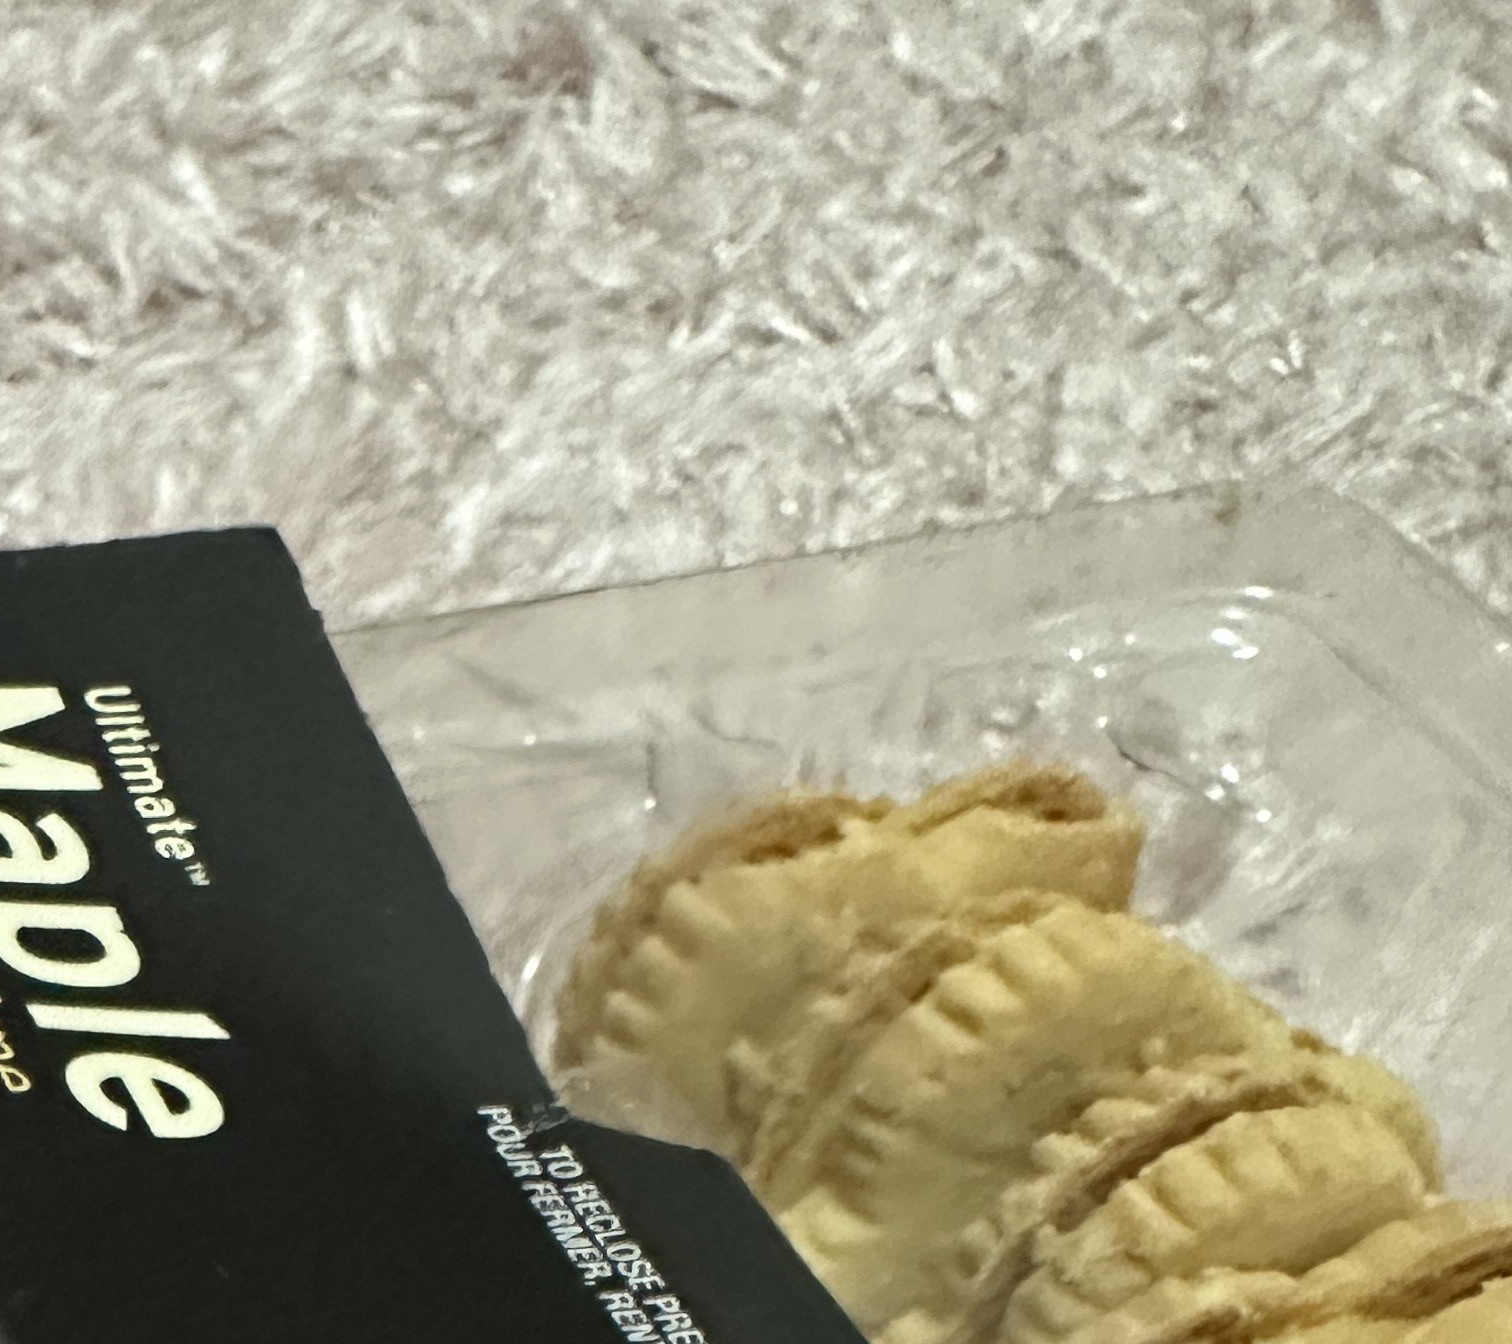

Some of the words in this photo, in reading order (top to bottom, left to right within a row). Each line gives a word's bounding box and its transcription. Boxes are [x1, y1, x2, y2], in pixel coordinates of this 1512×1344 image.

[477, 1105, 543, 1178] POUR
[540, 1144, 583, 1179] TO
[562, 1181, 665, 1290] RECLOSE
